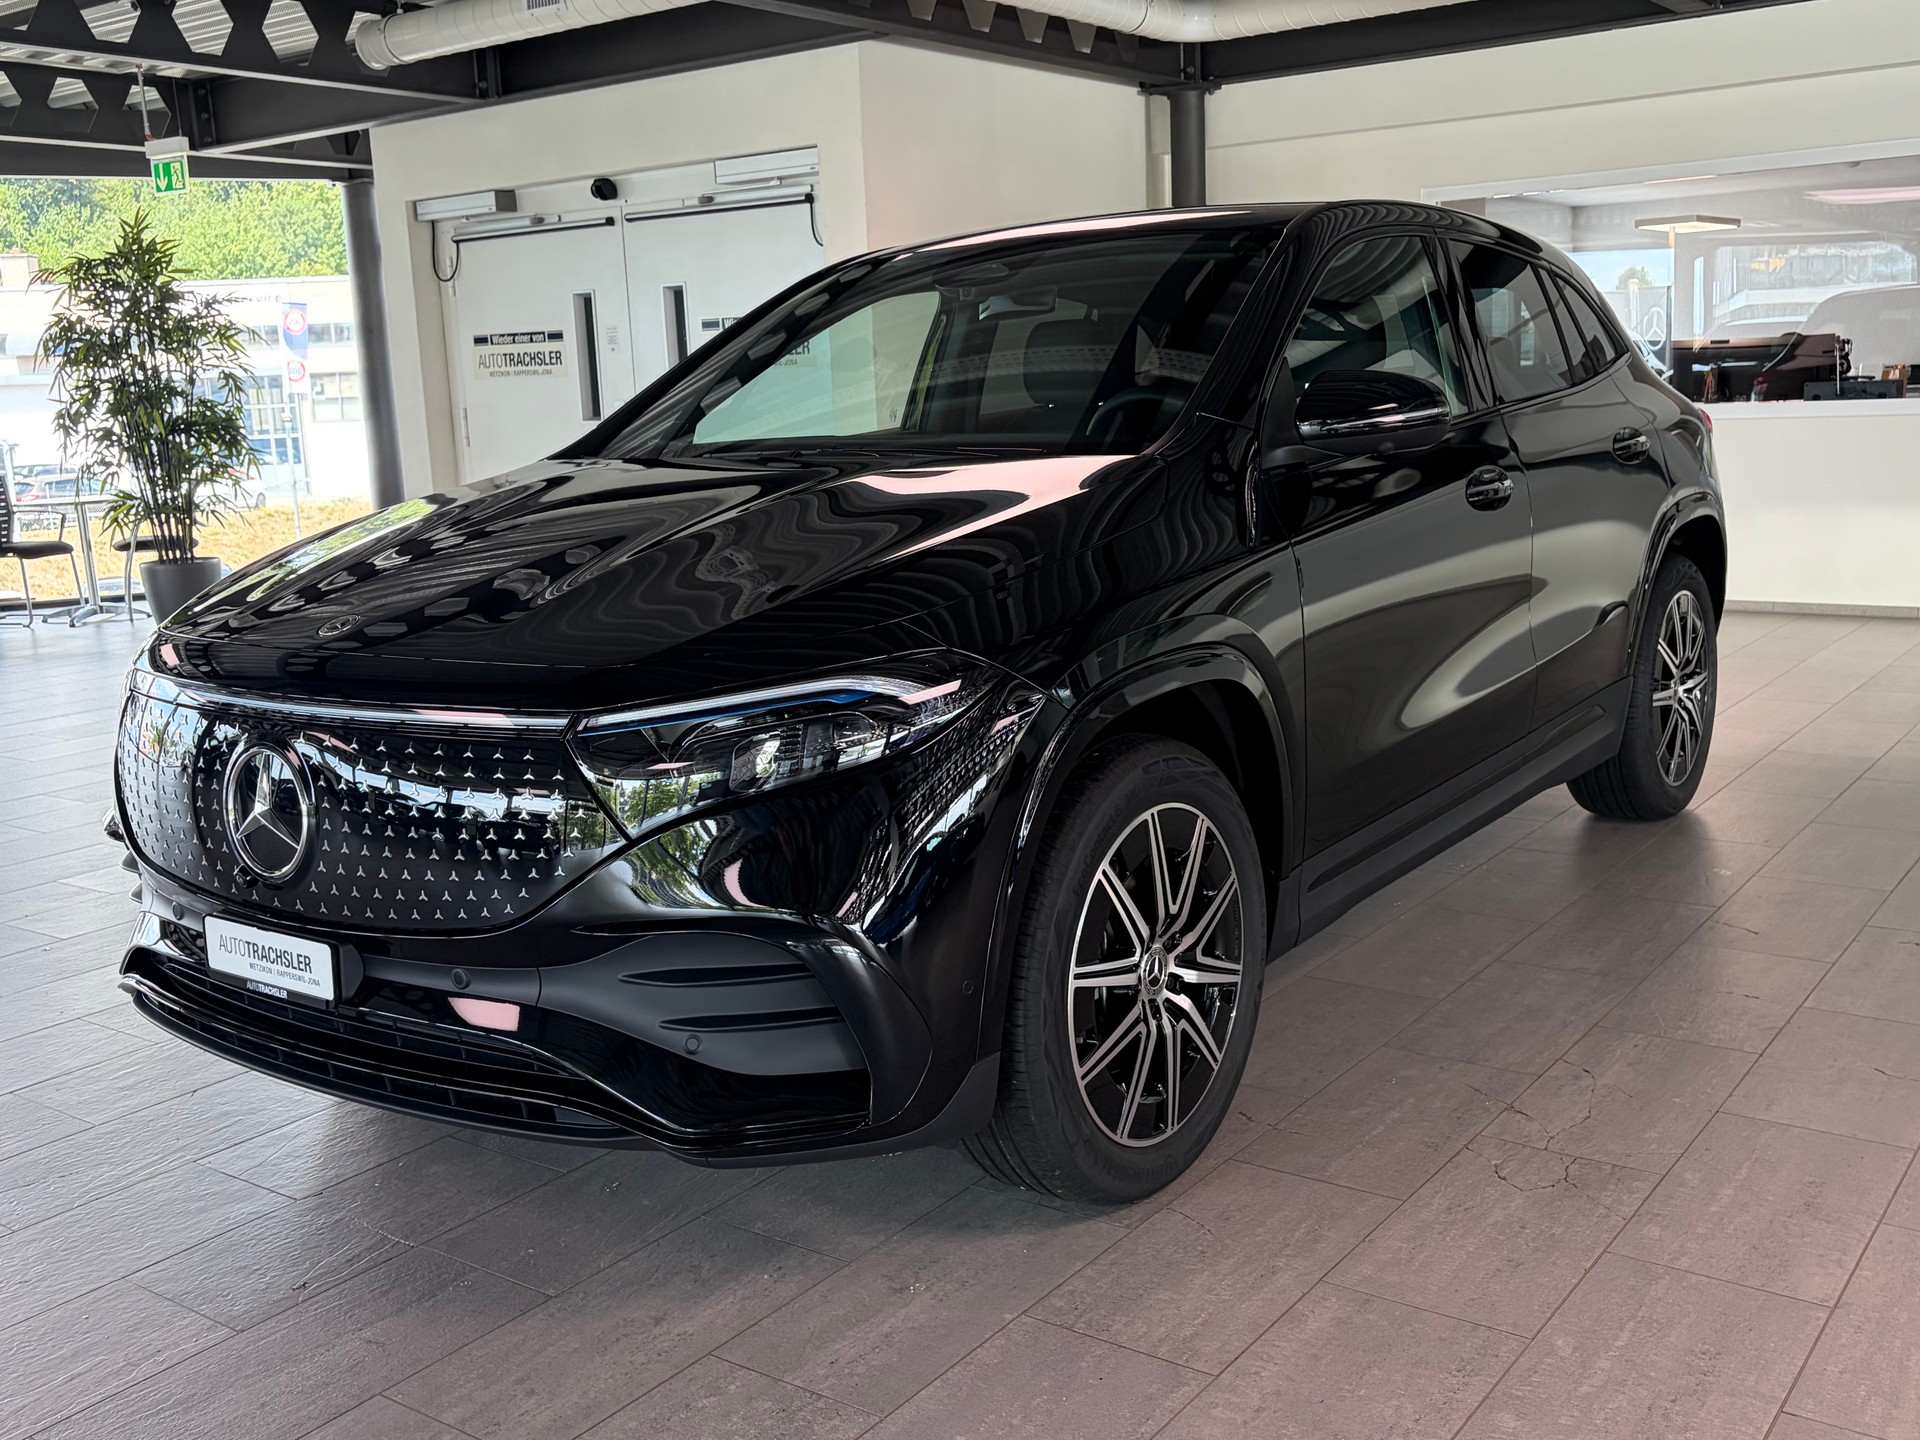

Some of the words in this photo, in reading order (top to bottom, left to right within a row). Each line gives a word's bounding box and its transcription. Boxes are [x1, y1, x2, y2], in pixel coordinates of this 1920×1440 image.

[491, 334, 514, 345] Wieder
[514, 333, 531, 344] einer
[531, 333, 545, 343] von
[478, 350, 563, 370] AUTOTRACHSLER
[219, 934, 313, 974] AUTOTRACHSLER
[249, 962, 273, 975] WETZIKON
[276, 969, 321, 987] RAPPERSWIL-JONA
[246, 980, 288, 999] AUTOTRACHSLER
